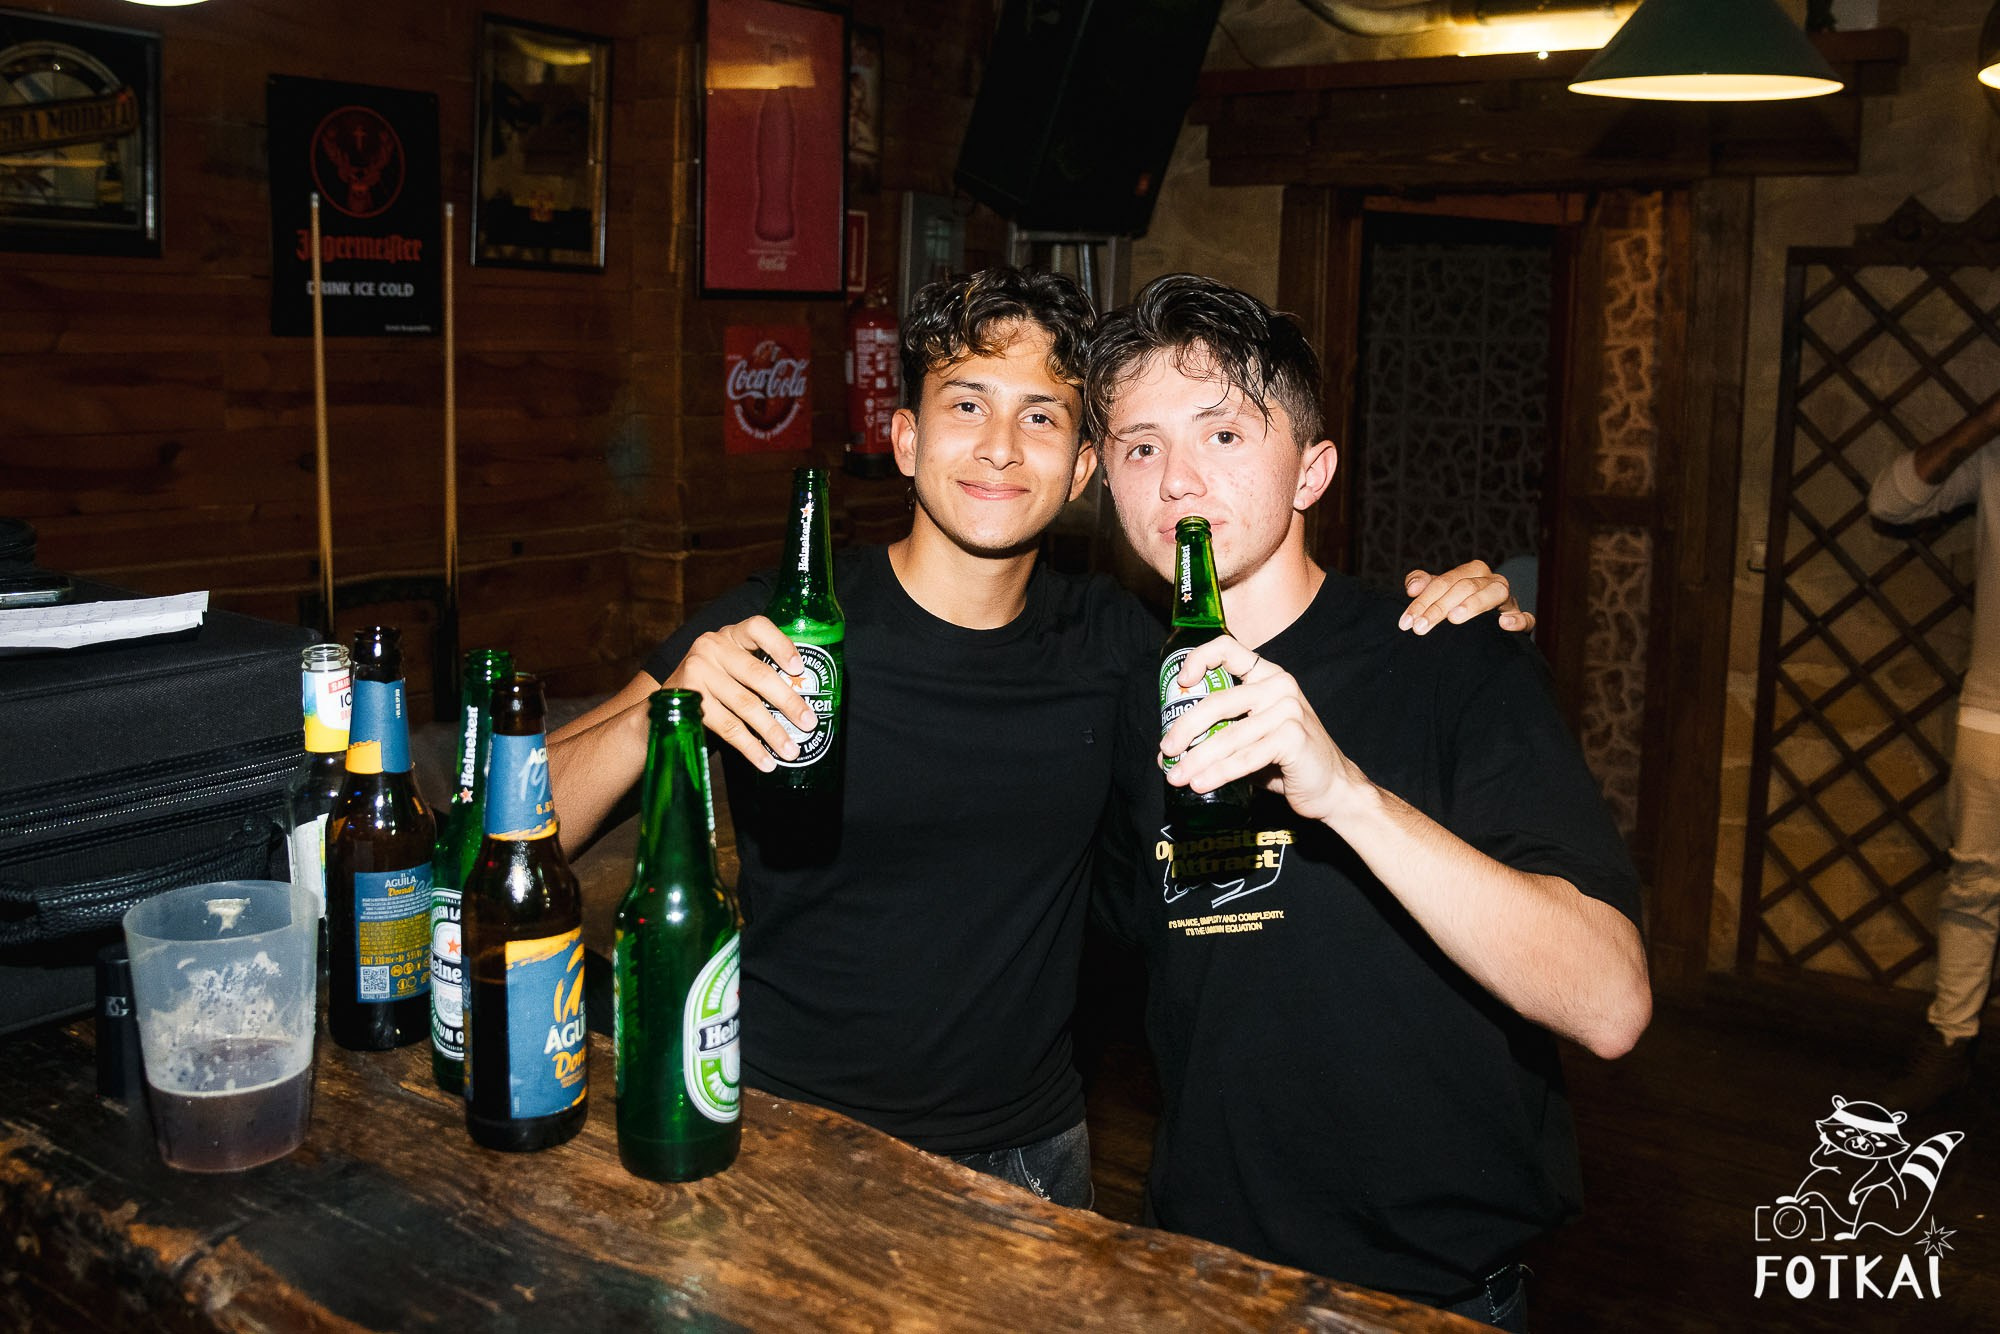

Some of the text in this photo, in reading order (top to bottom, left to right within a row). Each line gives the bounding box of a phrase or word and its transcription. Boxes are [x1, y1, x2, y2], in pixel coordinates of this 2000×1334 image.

[296, 229, 422, 264] Jgermeister
[353, 282, 375, 296] ICE
[378, 282, 414, 297] COLD
[798, 520, 811, 572] Heineken
[1181, 545, 1191, 593] Heineken
[801, 655, 830, 687] ORIGINAL
[461, 705, 478, 787] Heineken
[804, 730, 826, 754] LAGER
[1155, 830, 1295, 862] Opposites
[1172, 850, 1280, 878] Attract
[1222, 914, 1237, 923] AND
[1225, 922, 1263, 933] EQUATION
